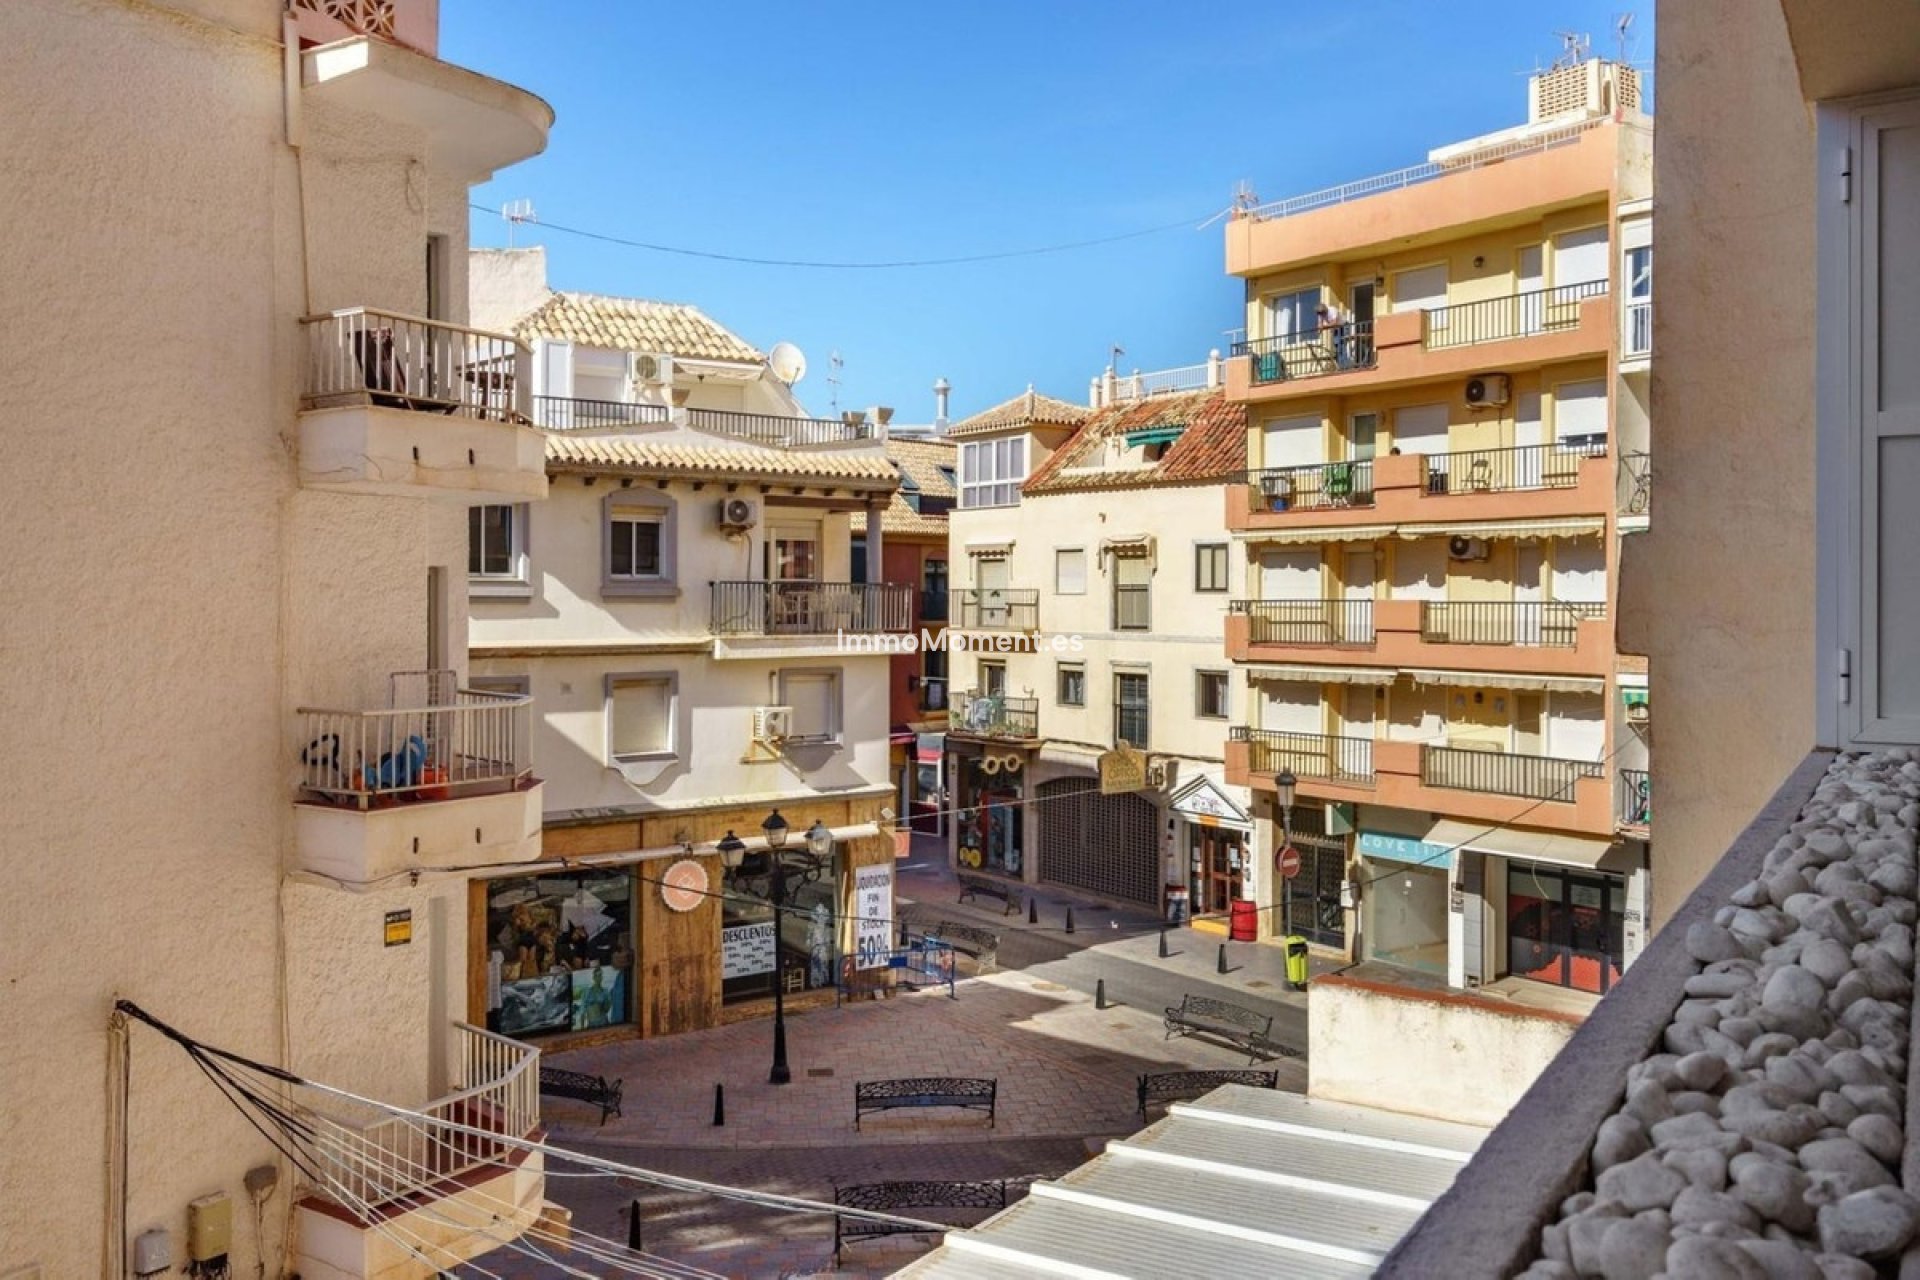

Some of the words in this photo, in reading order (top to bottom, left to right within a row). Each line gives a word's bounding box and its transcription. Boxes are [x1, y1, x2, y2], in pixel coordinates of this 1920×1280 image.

[1362, 837, 1407, 852] LOVE
[866, 893, 880, 902] FIN
[868, 906, 878, 916] DE
[858, 933, 890, 967] 50%
